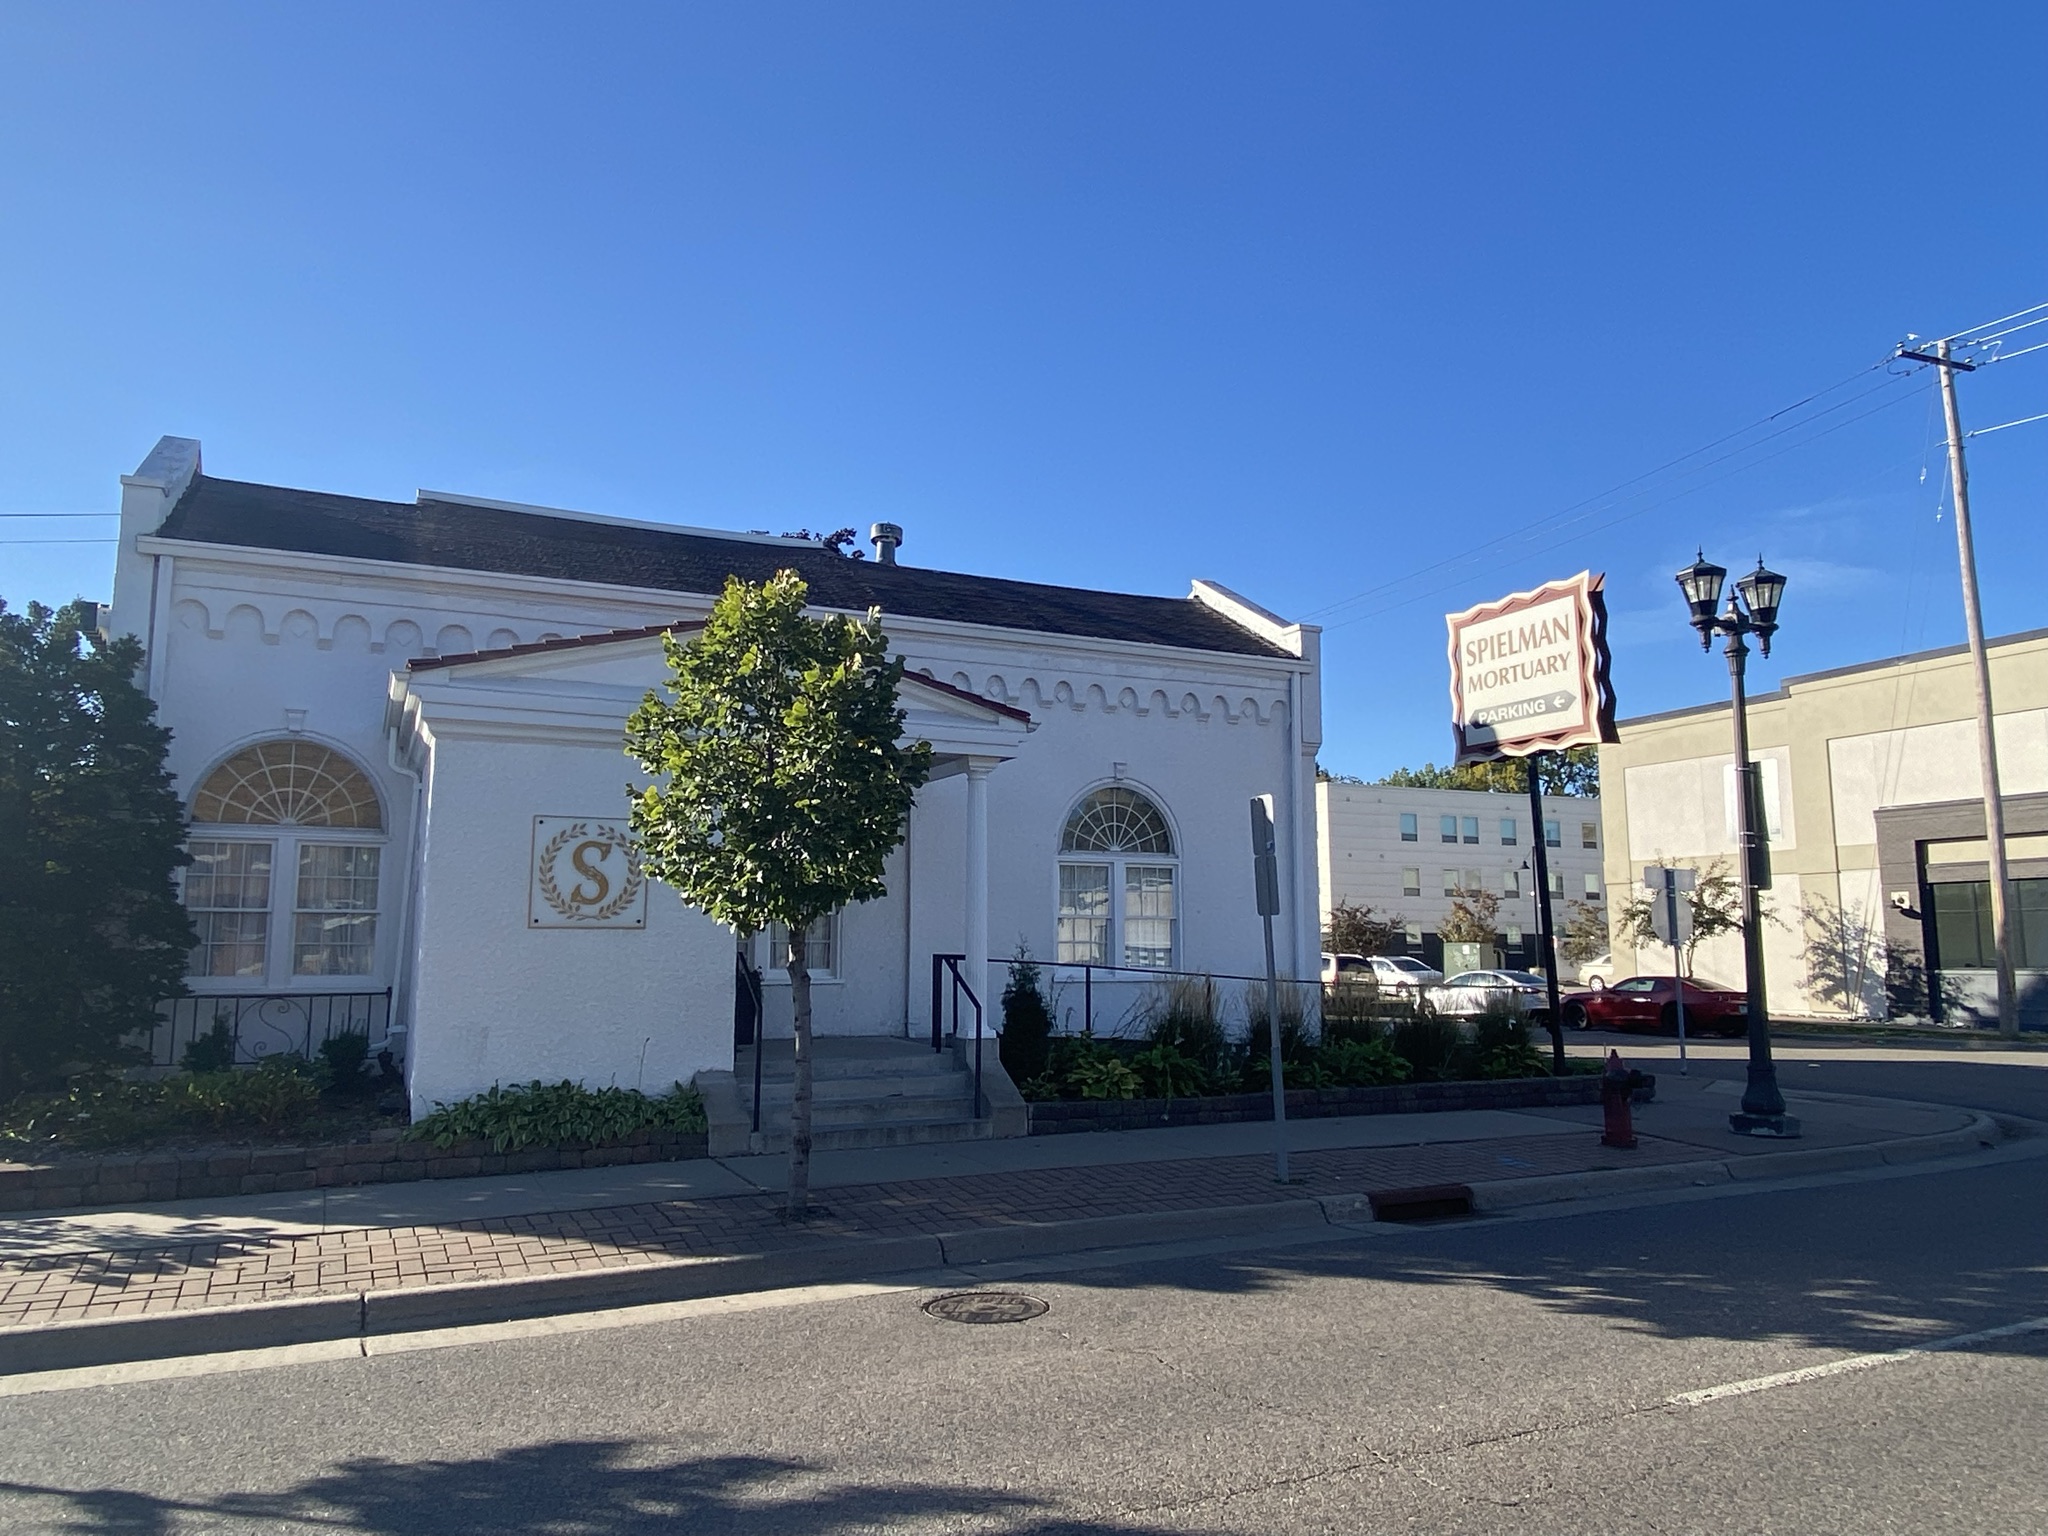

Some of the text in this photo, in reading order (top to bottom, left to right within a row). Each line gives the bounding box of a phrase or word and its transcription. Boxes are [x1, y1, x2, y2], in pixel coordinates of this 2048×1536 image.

[1466, 614, 1570, 667] SPIELMAN
[1468, 651, 1571, 694] MORTUARY
[1478, 699, 1546, 725] PARKING
[570, 840, 613, 905] S
